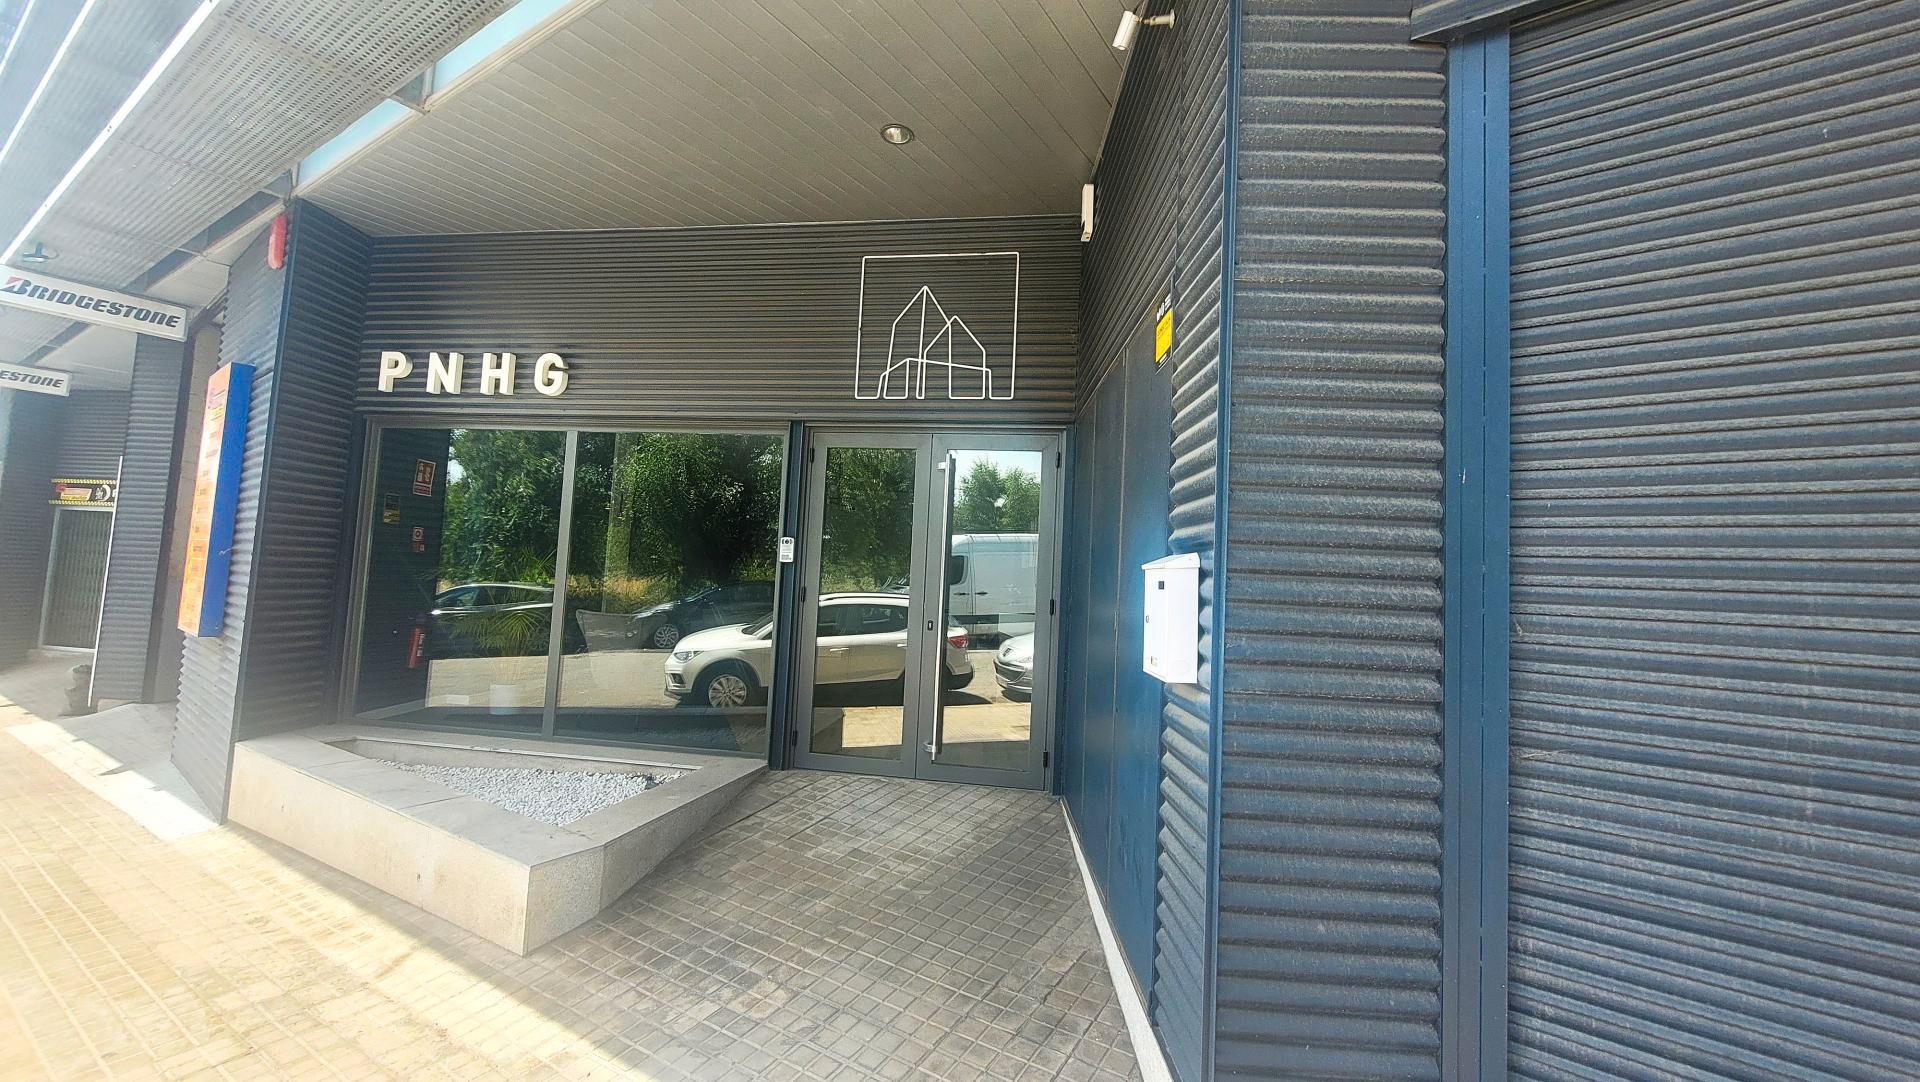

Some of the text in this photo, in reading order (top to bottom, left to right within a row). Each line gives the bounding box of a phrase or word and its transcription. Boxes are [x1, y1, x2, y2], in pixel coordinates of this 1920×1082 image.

[0, 276, 182, 328] BRIDGESTONE
[0, 370, 65, 388] ESTONE
[377, 350, 570, 397] PNHG
